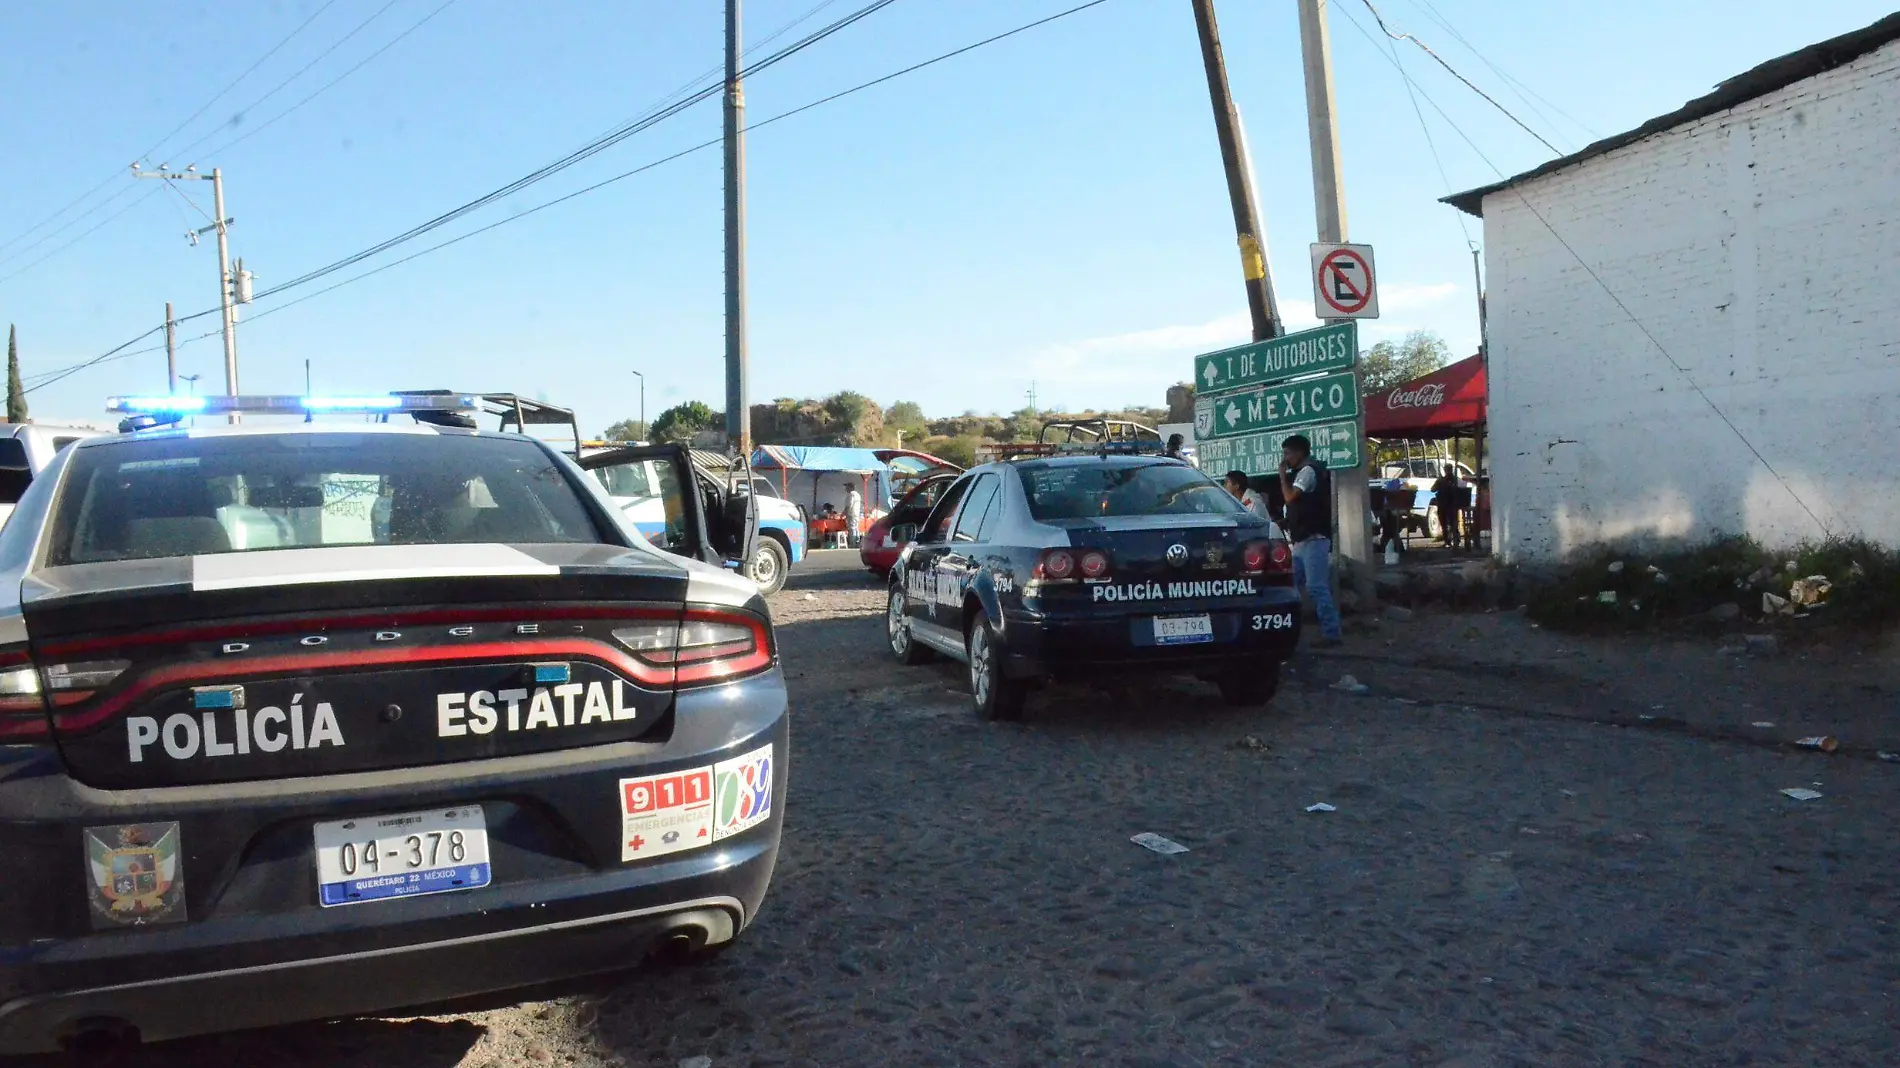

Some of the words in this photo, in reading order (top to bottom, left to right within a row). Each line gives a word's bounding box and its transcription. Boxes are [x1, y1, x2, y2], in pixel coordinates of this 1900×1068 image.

[1226, 357, 1235, 379] T.
[1241, 352, 1256, 377] DE
[1264, 332, 1346, 373] AUTOBUSES
[1248, 383, 1344, 422] MEXICO
[1199, 413, 1209, 429] 57
[1200, 441, 1231, 461] BARRIO
[1236, 439, 1247, 456] DE
[1254, 436, 1264, 455] LA
[1316, 428, 1330, 446] KM
[1201, 459, 1228, 476] SALIDA
[993, 575, 1013, 593] 3794
[1093, 580, 1163, 601] POLICÍA
[1168, 579, 1257, 598] MUNICIPAL
[1252, 613, 1293, 630] 3794
[222, 623, 539, 654] DODGE
[437, 679, 637, 738] ESTATAL
[126, 692, 346, 763] POLICÍA
[631, 776, 703, 810] 911
[718, 757, 771, 827] 089
[626, 809, 710, 833] EMERGENCIAS
[340, 830, 466, 876] 04-378
[356, 875, 405, 891] QUERÉTARO
[409, 874, 420, 882] 22
[424, 869, 457, 880] MÉXICO
